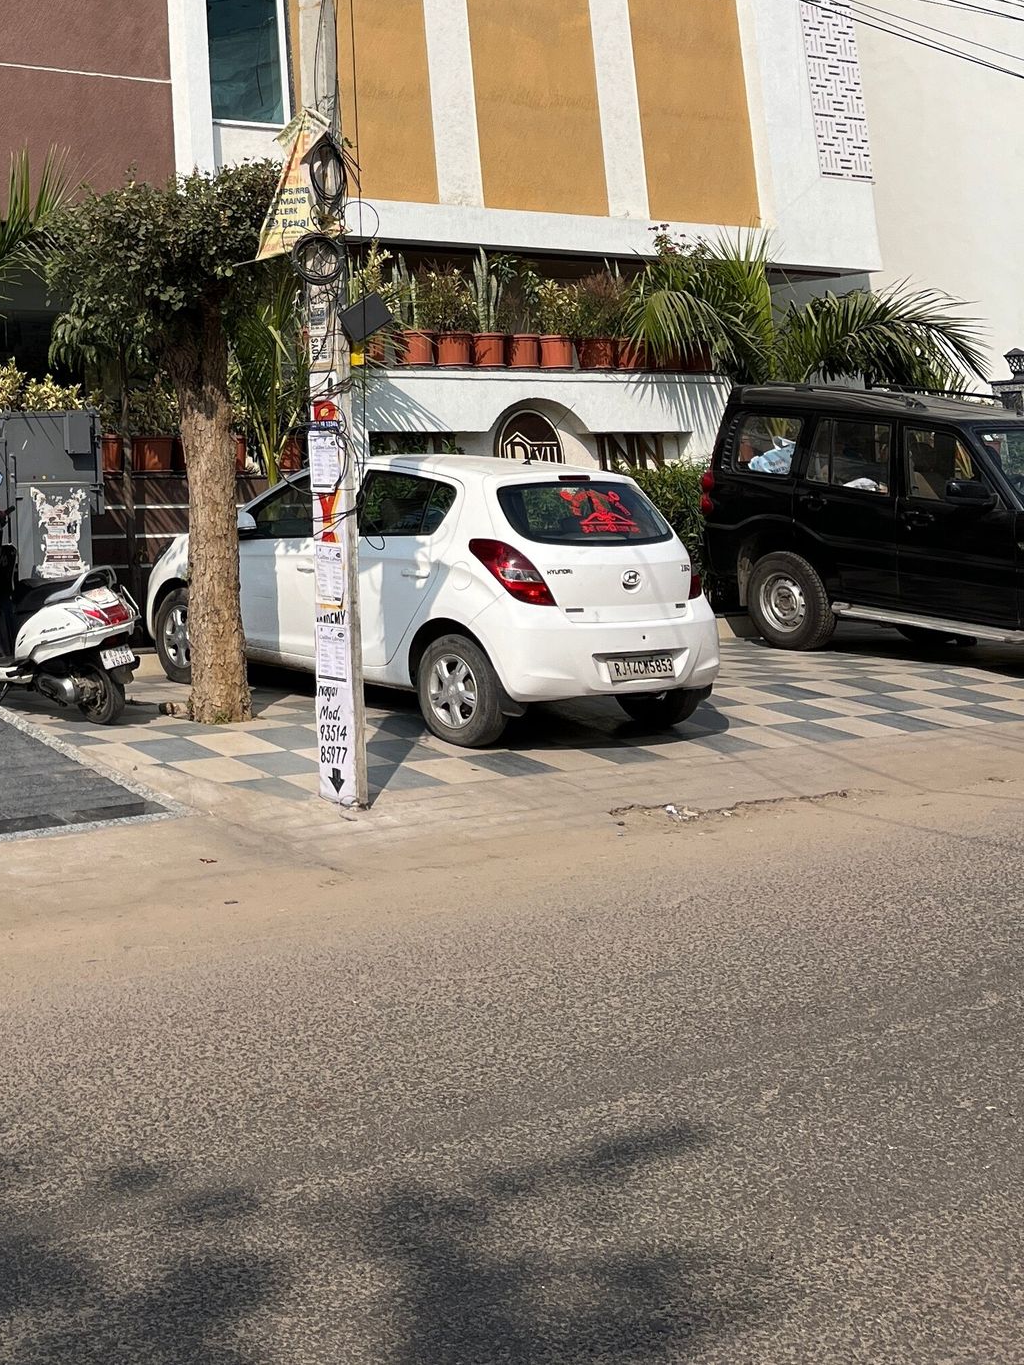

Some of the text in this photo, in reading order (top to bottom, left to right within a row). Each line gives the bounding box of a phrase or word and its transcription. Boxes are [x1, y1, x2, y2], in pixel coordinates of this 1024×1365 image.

[280, 196, 307, 206] MAINS
[615, 658, 673, 677] RJ14CM5853
[320, 724, 347, 742] 93514
[320, 745, 348, 764] 85977
